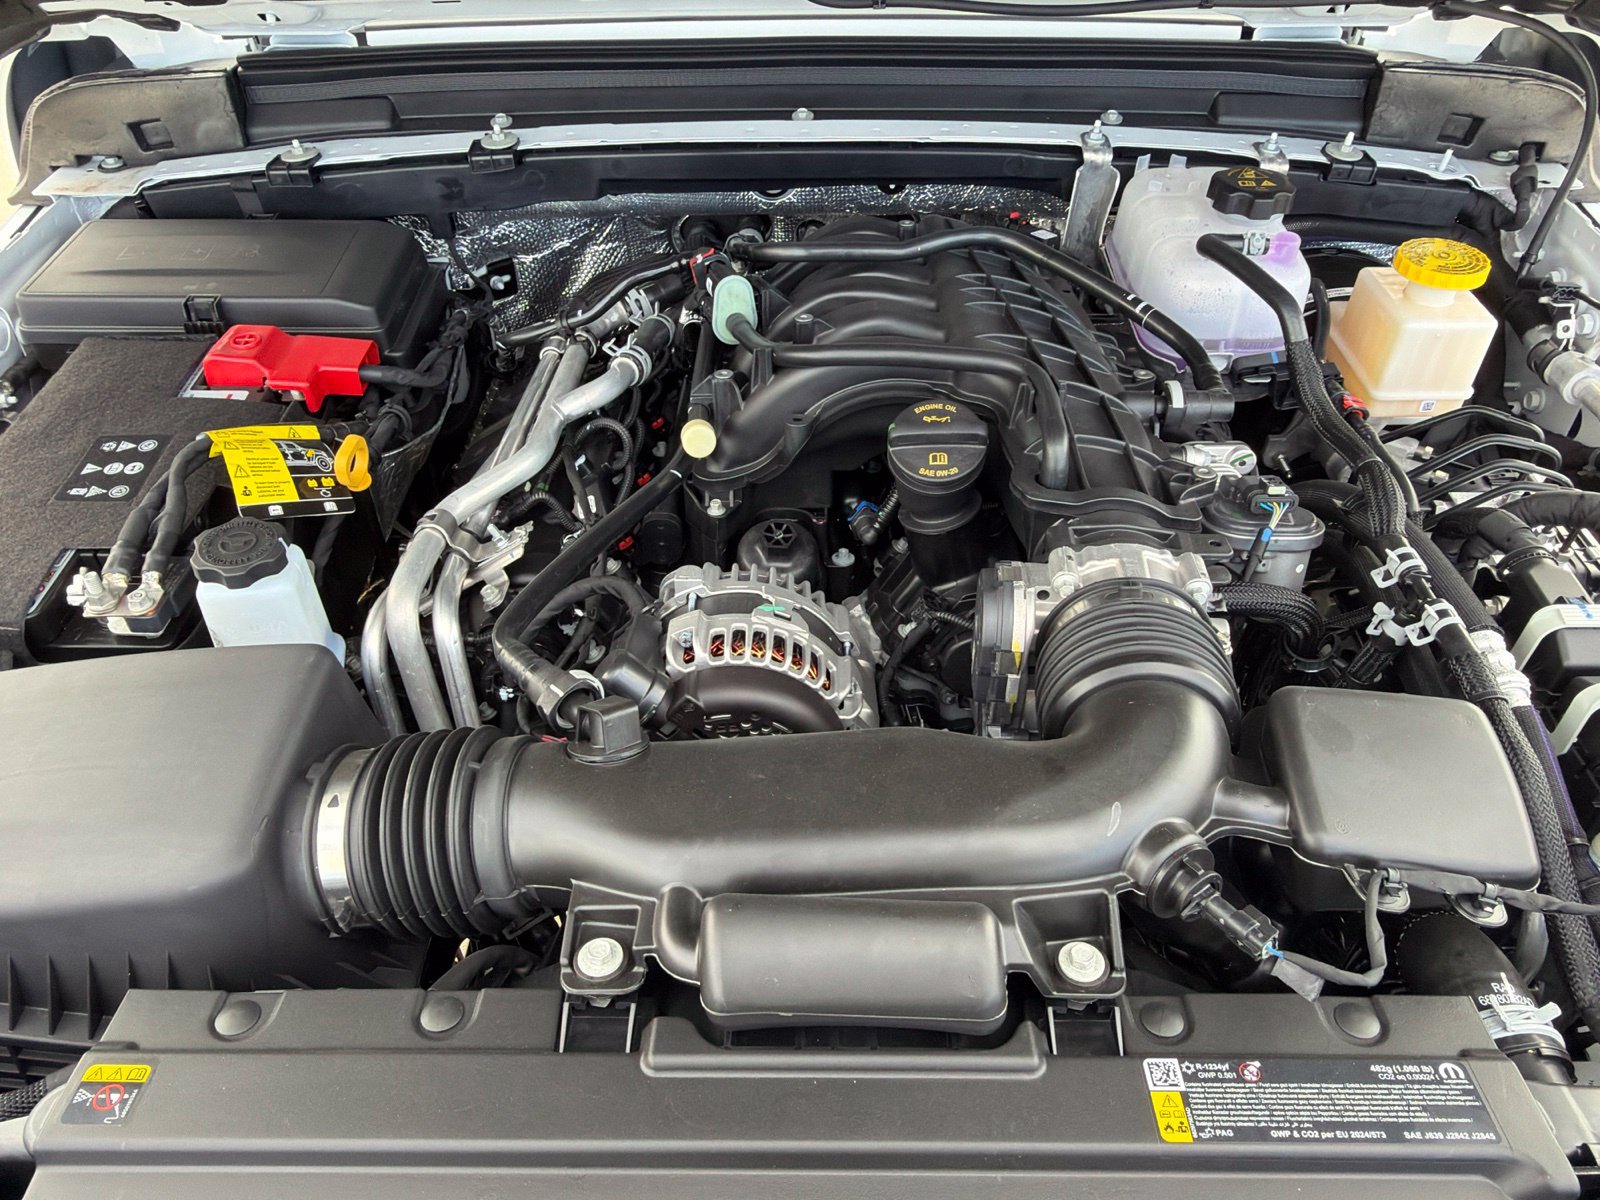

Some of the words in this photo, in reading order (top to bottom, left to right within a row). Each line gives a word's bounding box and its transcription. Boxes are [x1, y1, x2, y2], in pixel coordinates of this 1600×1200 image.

[914, 404, 943, 414] ENGINE
[945, 404, 957, 413] OIL
[918, 467, 935, 477] SAE
[936, 466, 959, 477] 0W-20
[1195, 1063, 1229, 1071] R-1234yf
[1215, 1129, 1234, 1137] PAG
[1270, 1130, 1291, 1138] GWP
[1301, 1130, 1320, 1138] CO2
[1320, 1131, 1335, 1139] per
[1335, 1130, 1349, 1138] EU
[1403, 1131, 1423, 1139] SAE
